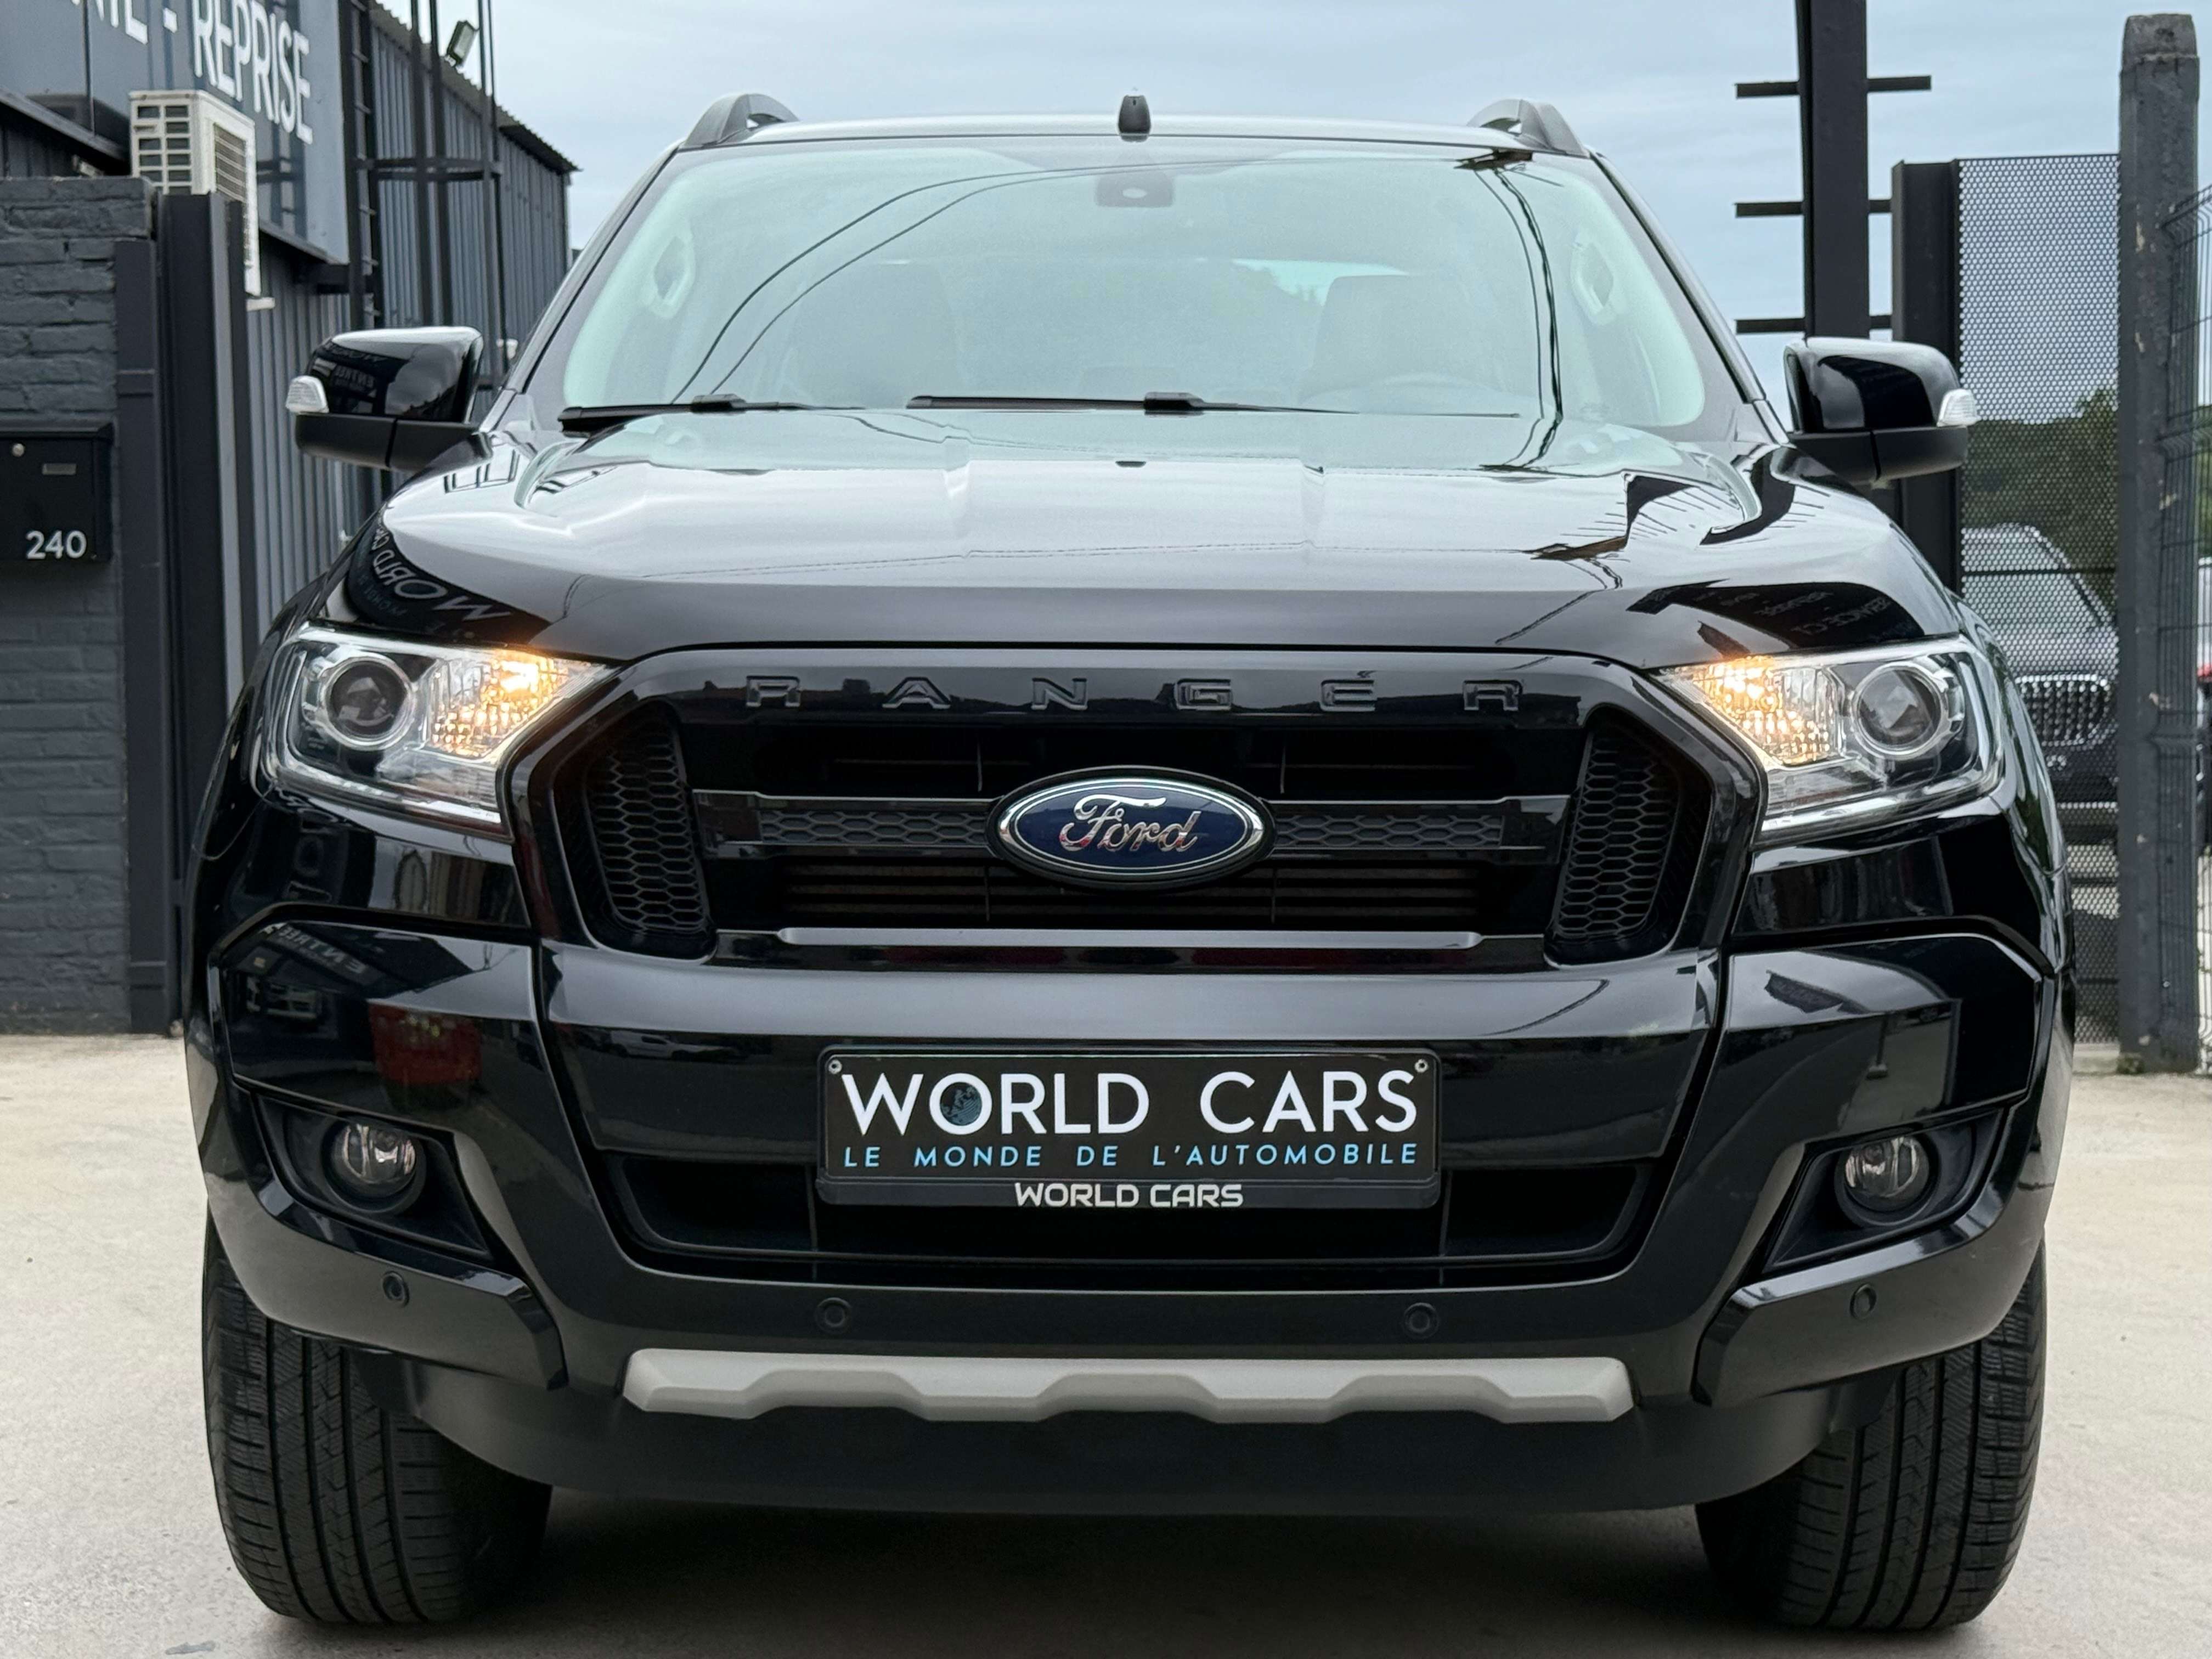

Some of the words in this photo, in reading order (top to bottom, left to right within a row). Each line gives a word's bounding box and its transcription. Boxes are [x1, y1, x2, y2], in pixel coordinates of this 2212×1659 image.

[193, 0, 313, 144] REPRISE
[26, 530, 87, 559] 240
[746, 675, 1523, 712] RANGER
[1059, 794, 1202, 852] Ford
[841, 1071, 1150, 1136] WORLD
[1200, 1070, 1418, 1134] CARS
[844, 1147, 881, 1167] LE
[914, 1146, 1042, 1167] MONDE
[1076, 1146, 1119, 1166] DE
[1153, 1143, 1417, 1166] L'AUTOMOBILE
[1014, 1182, 1139, 1207] WORLD
[1149, 1183, 1244, 1208] CARS
